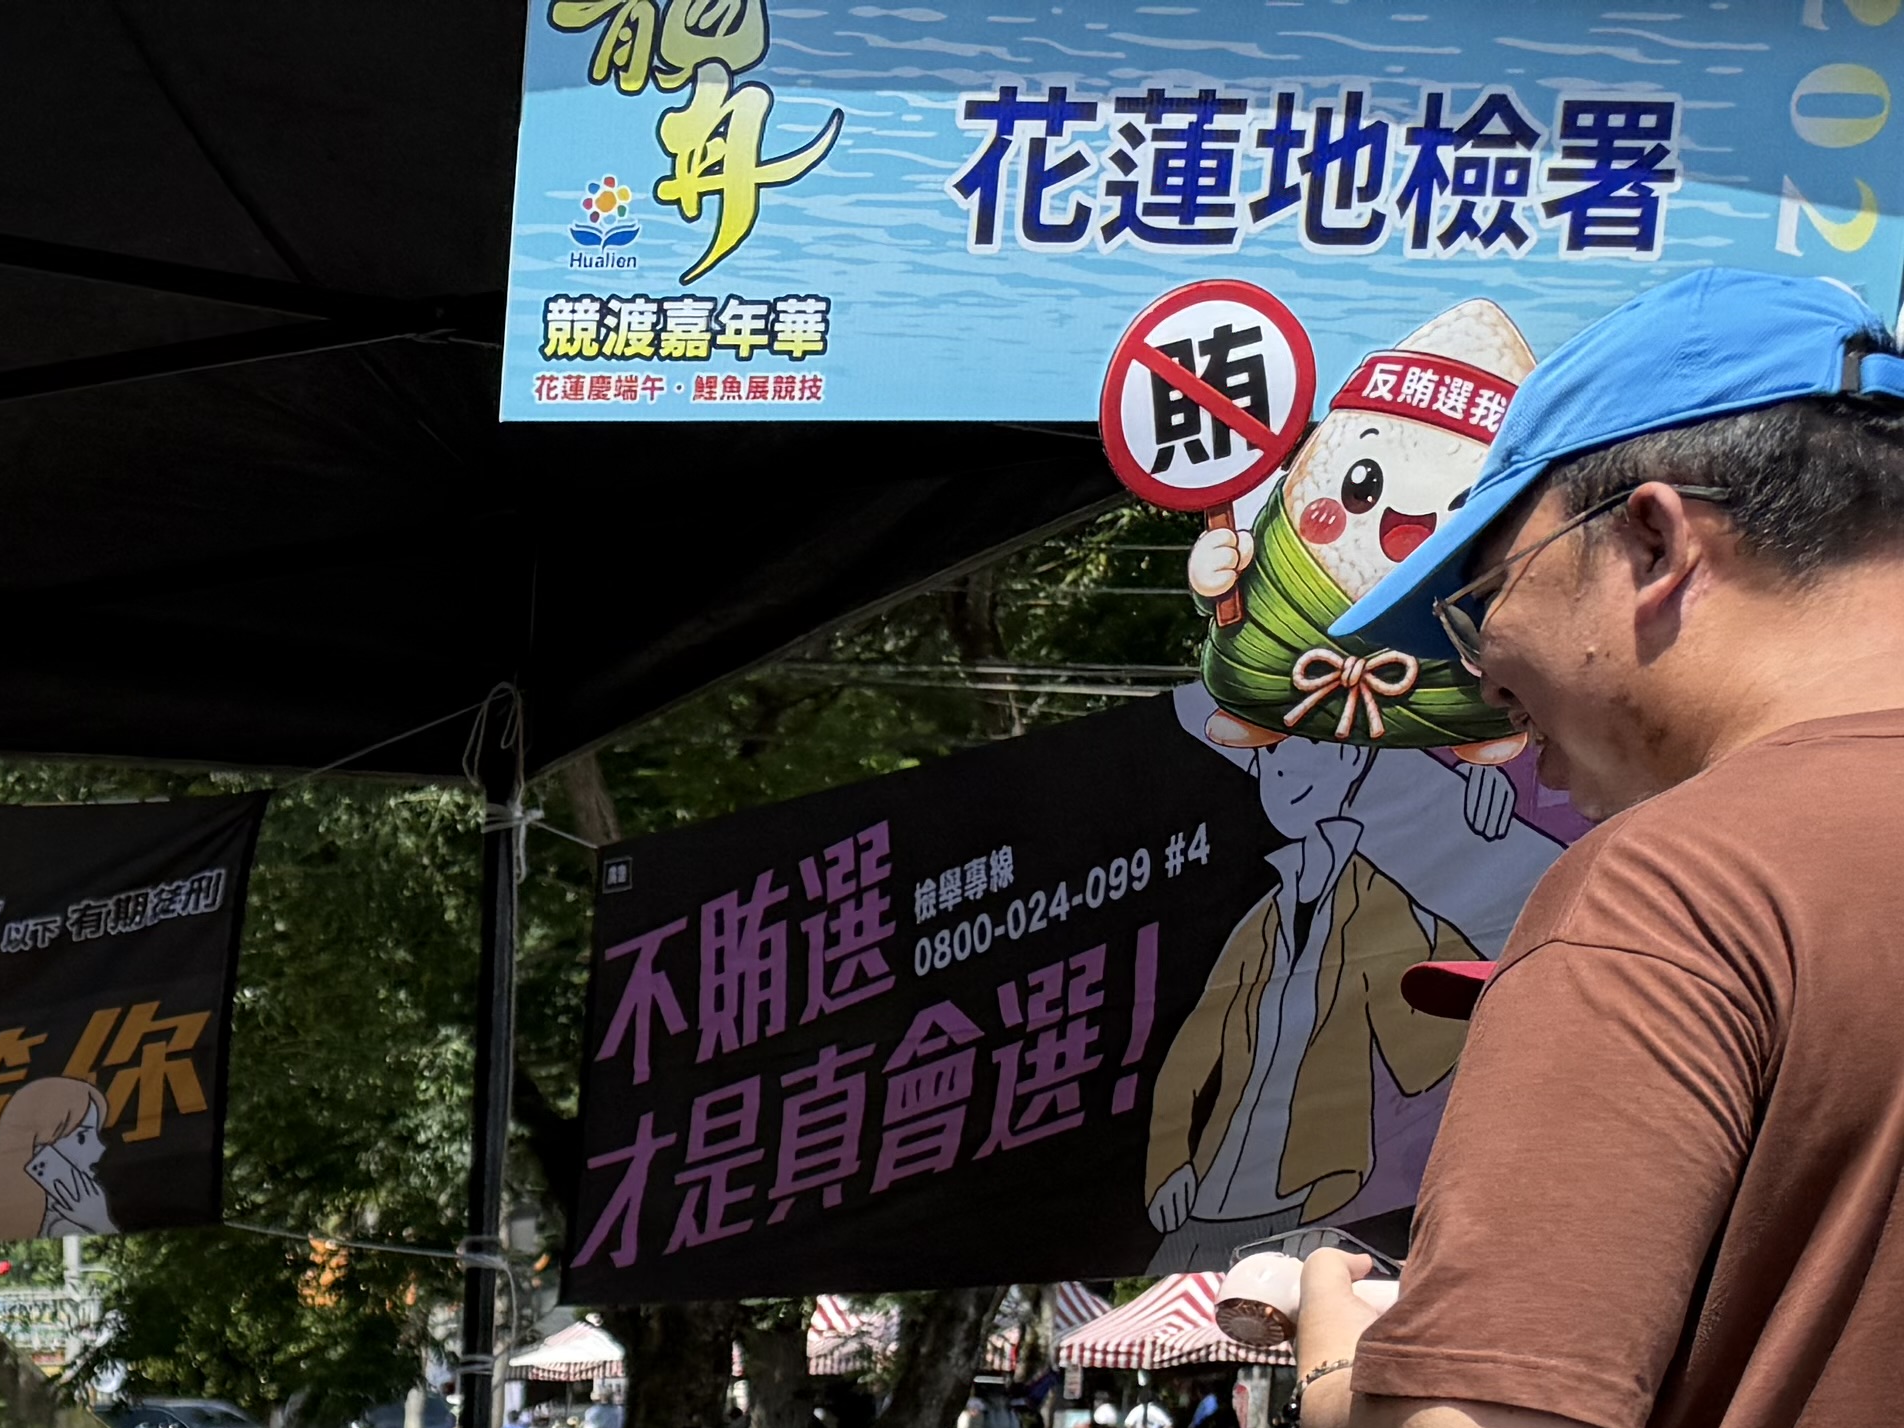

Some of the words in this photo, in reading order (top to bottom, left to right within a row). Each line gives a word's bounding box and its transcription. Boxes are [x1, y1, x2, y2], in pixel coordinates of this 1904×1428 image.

[954, 84, 1679, 257] 花蓮地檢署
[569, 250, 637, 270] Hualien
[540, 293, 830, 361] 競渡嘉年華
[913, 845, 1015, 926] 檢舉專線
[913, 849, 1152, 977] 0800-024-099
[595, 819, 897, 1086] 不賄選
